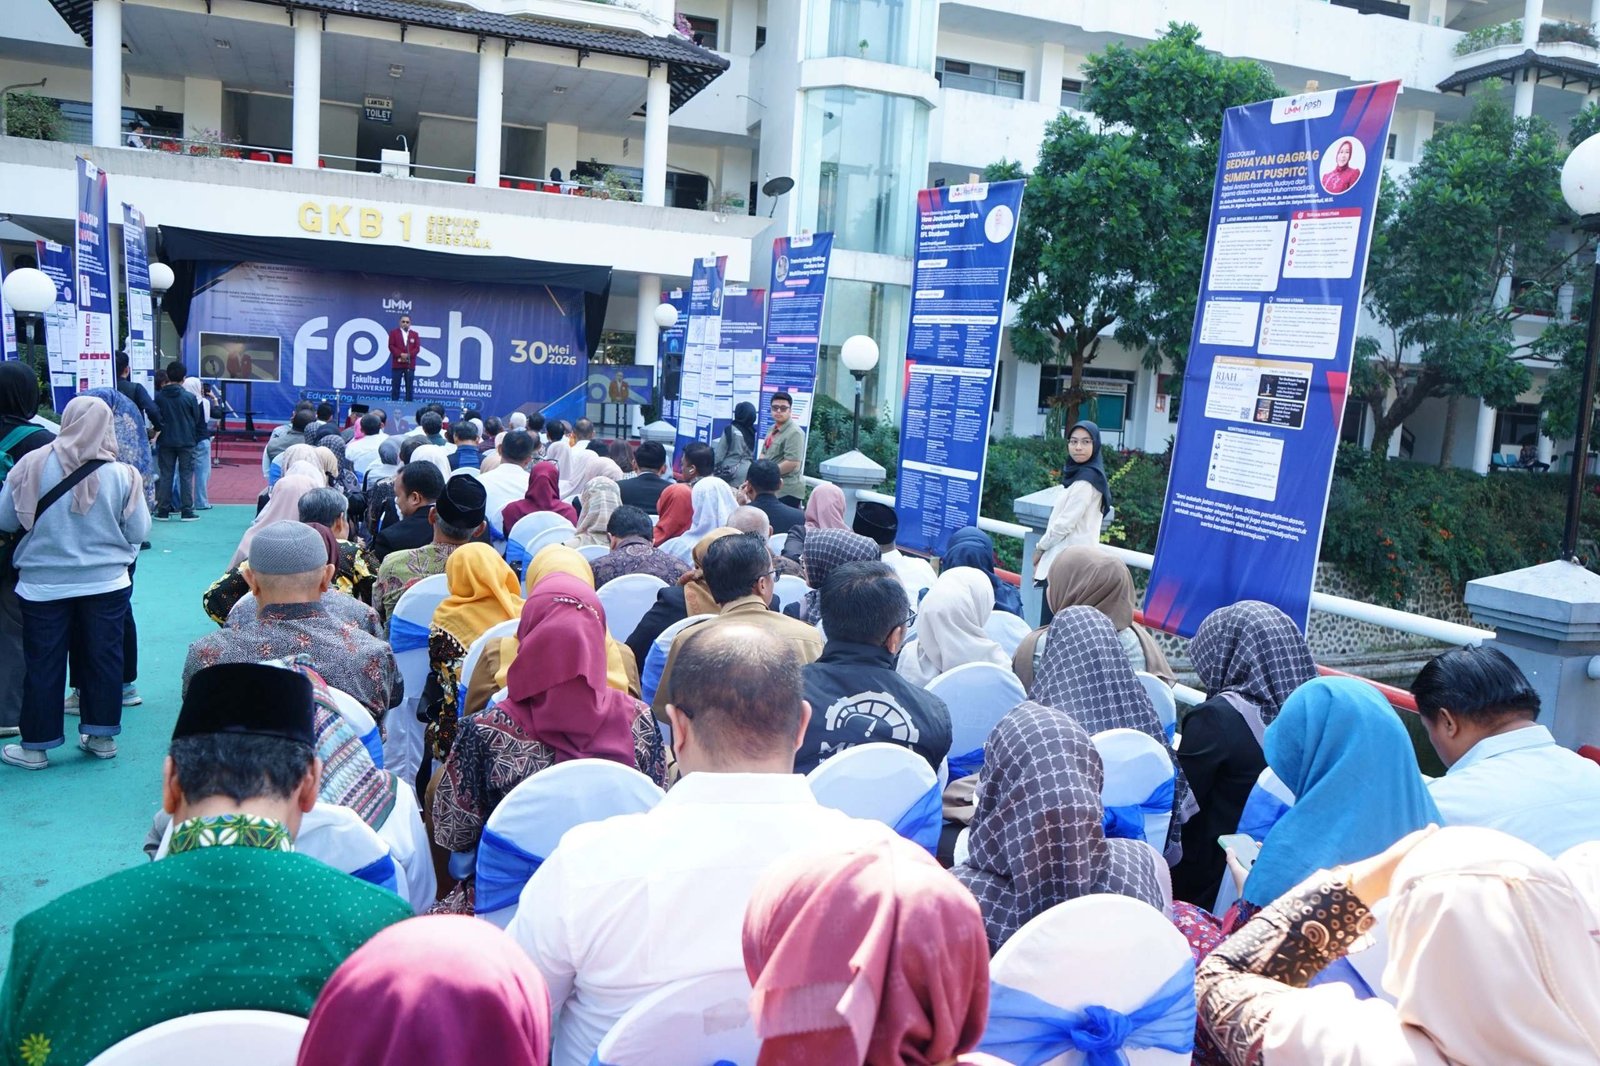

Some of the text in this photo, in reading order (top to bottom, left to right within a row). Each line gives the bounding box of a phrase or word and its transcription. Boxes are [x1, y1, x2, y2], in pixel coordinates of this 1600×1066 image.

[366, 108, 391, 118] TOILET
[1226, 150, 1320, 170] BEDHAYAN GAGRAG
[1224, 166, 1308, 184] SUMIRAT PUSPITO:
[298, 202, 413, 242] GKB 1
[428, 215, 480, 228] GEDUNG
[427, 224, 476, 238] KULIAH
[426, 233, 492, 249] BERSAMA
[382, 298, 412, 310] UMM
[510, 340, 569, 364] 30 Mei
[549, 356, 576, 366] 2026
[352, 374, 379, 384] Fakultas
[440, 380, 451, 388] dan
[453, 380, 492, 391] Humaniora
[1216, 371, 1237, 382] RJAH
[352, 383, 393, 392] UNIVERSITA
